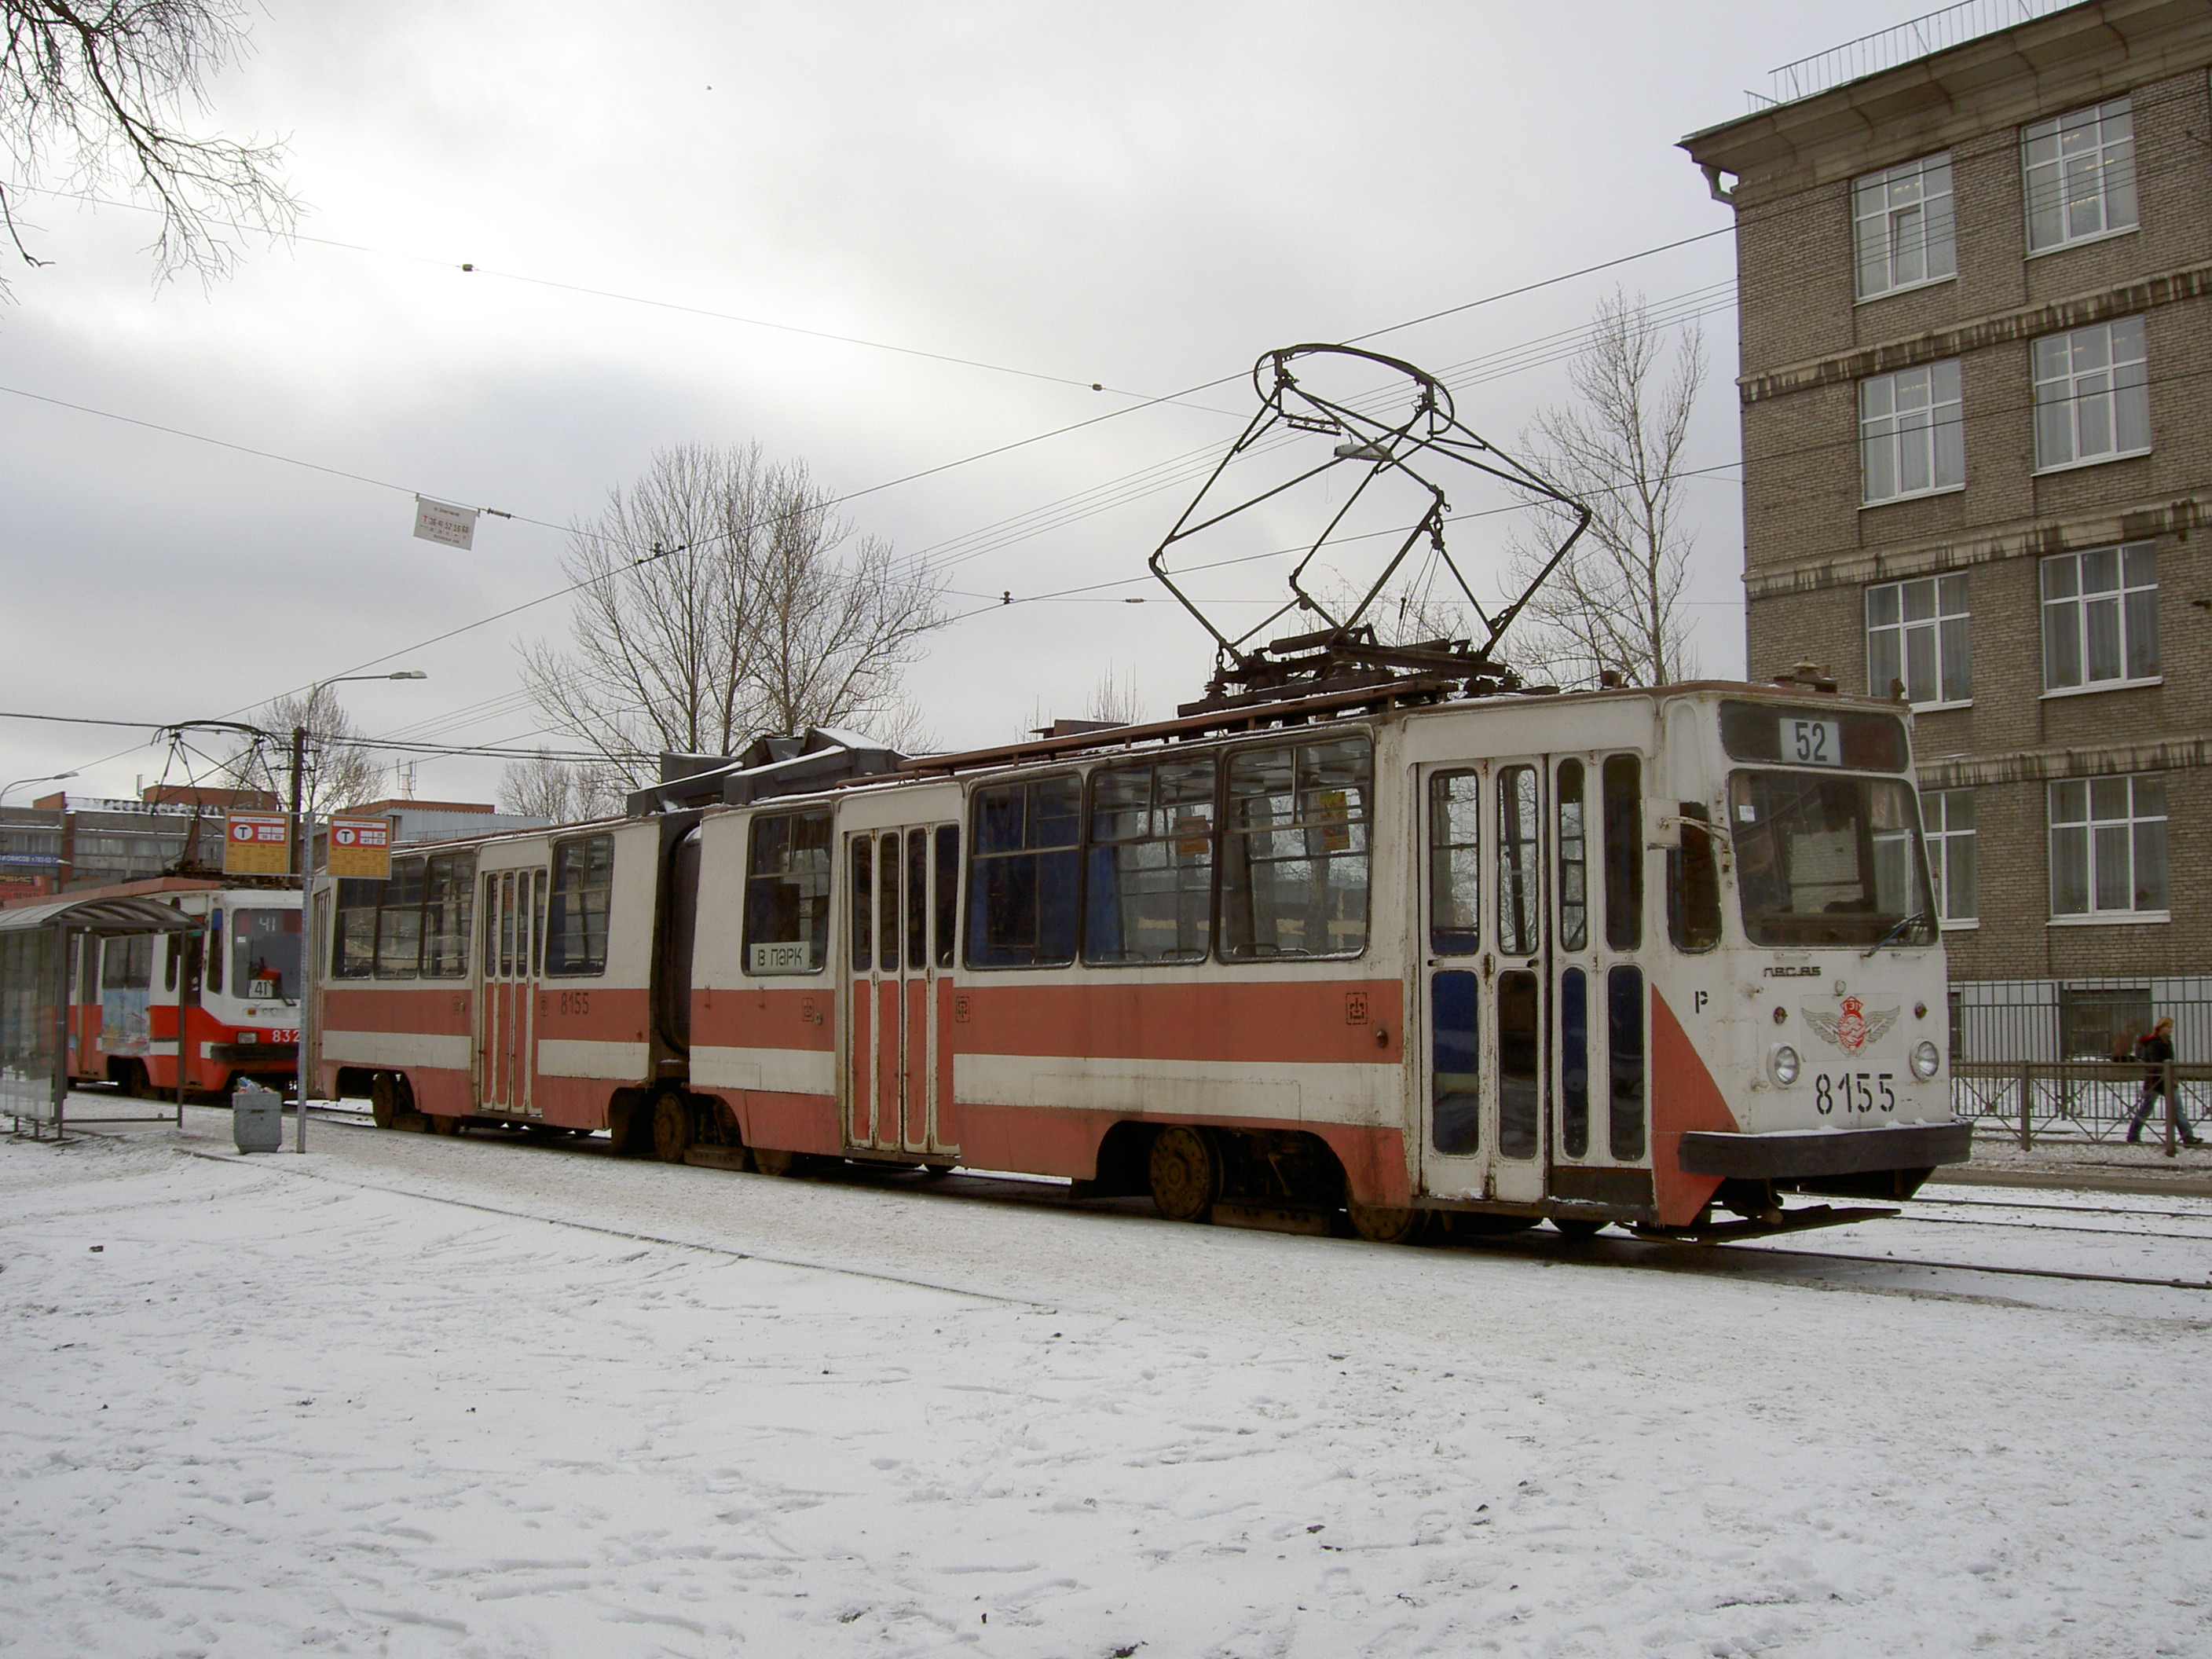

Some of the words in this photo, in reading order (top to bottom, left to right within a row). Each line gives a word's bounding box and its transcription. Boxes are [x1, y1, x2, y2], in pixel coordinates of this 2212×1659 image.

[445, 522, 452, 530] 52
[1795, 722, 1827, 761] 52
[259, 917, 276, 932] 41
[255, 981, 267, 996] 41
[561, 992, 589, 1015] 8155
[1815, 1073, 1895, 1115] 8155
